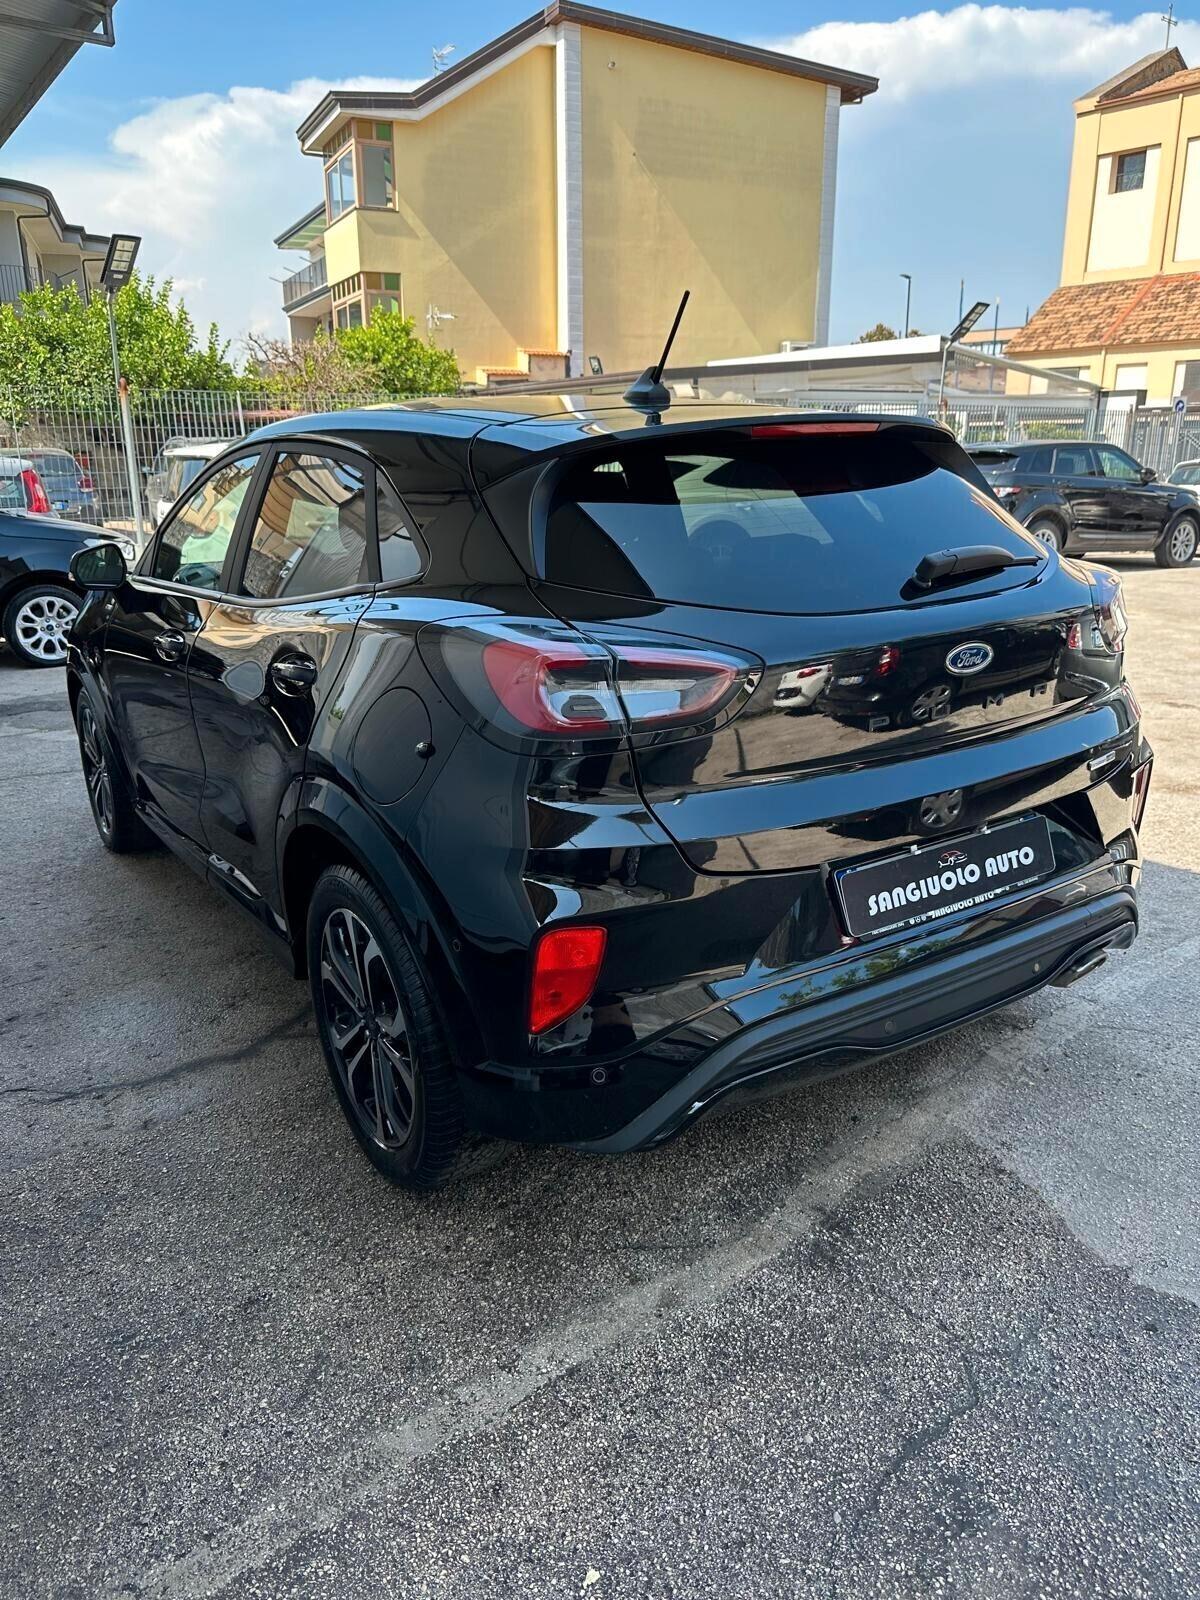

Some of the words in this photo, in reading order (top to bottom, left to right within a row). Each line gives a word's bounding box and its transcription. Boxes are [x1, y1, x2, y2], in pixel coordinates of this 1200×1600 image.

[957, 649, 983, 667] Ford
[868, 863, 981, 917] SANGIUOLO
[985, 846, 1035, 877] AUTO
